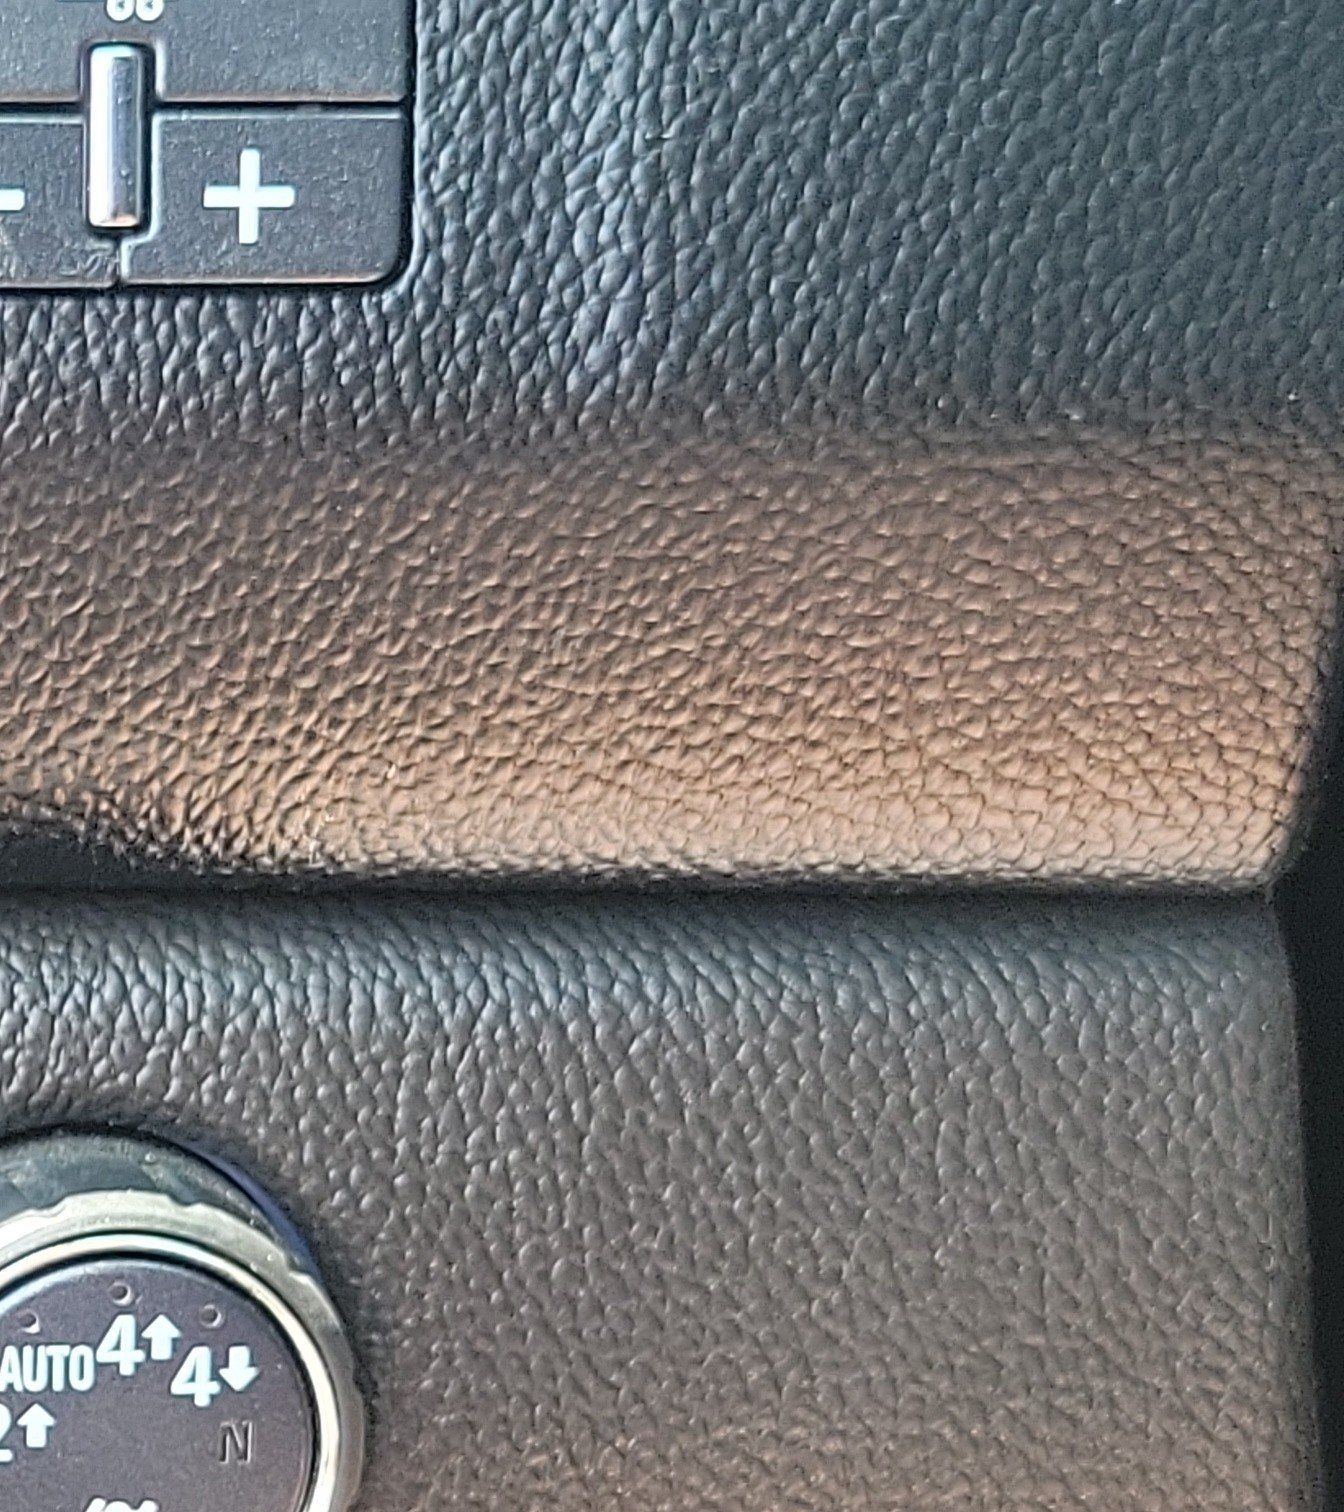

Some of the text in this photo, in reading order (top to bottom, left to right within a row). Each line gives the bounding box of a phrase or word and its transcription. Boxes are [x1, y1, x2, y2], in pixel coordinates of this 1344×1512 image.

[95, 1313, 146, 1376] 4
[170, 1345, 221, 1408] 4
[219, 1421, 254, 1466] N
